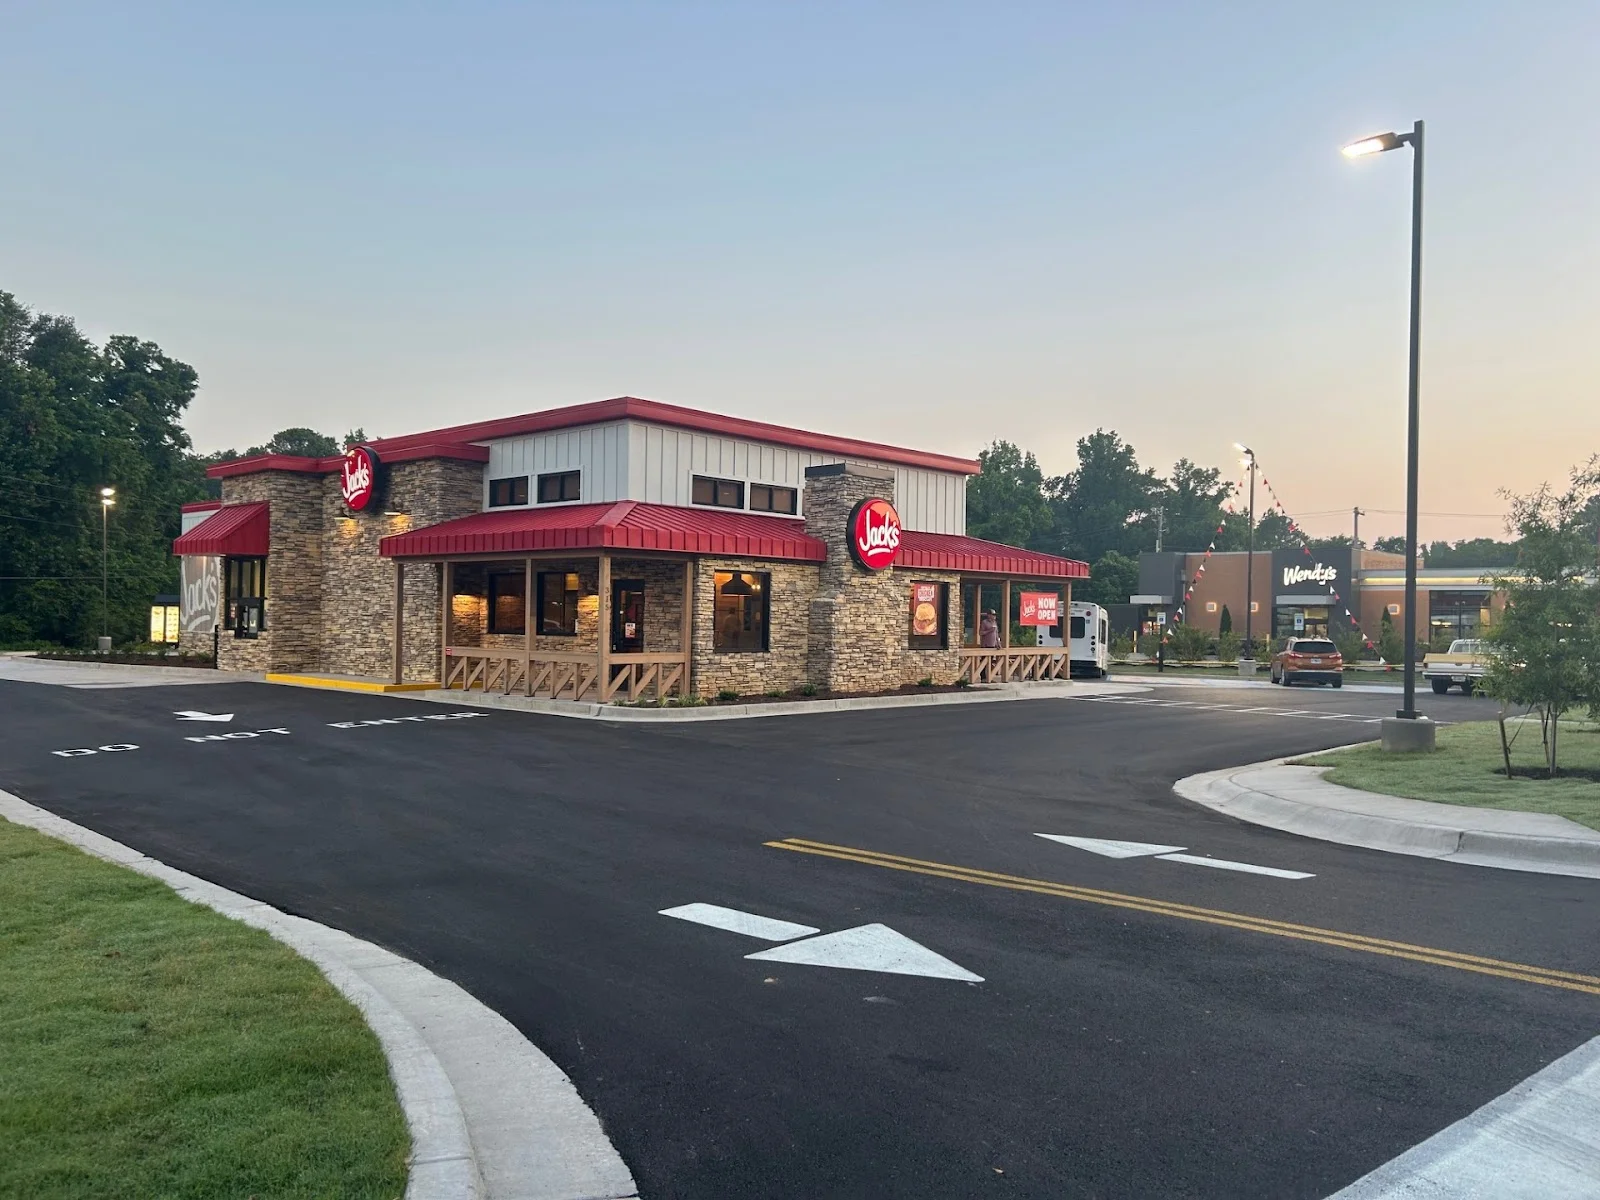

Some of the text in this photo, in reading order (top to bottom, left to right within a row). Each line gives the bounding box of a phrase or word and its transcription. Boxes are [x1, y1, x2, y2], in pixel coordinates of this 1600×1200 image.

[342, 454, 370, 499] Jack's
[859, 508, 900, 551] Jack's
[180, 556, 217, 625] Jack's
[1283, 562, 1338, 586] Wendy's
[1037, 597, 1056, 609] NOW
[1037, 609, 1056, 620] OPEN
[51, 712, 491, 757] DO NOT ENTER
